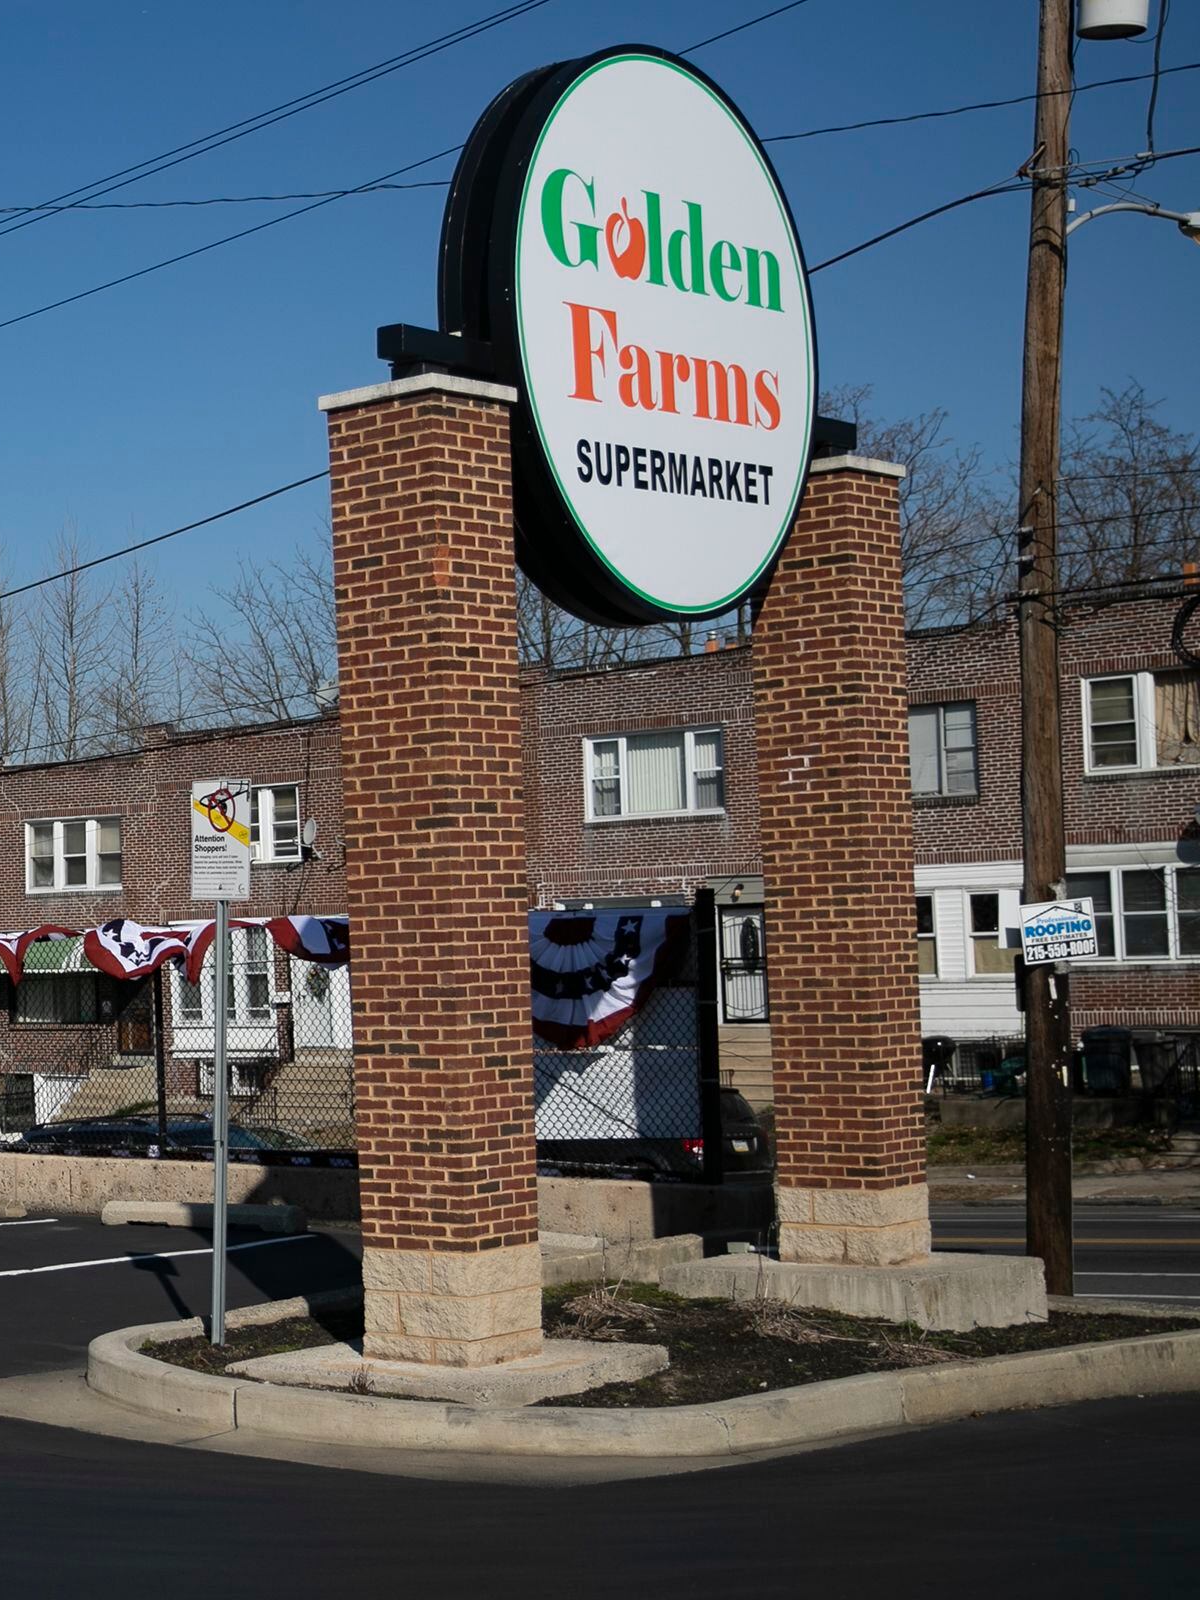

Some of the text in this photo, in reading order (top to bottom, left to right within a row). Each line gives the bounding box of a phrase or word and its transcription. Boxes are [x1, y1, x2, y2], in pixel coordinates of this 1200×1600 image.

[540, 168, 785, 312] Golden
[562, 301, 781, 431] Farms
[576, 438, 774, 506] SUPERMARKET
[194, 844, 227, 852] Shoppers!
[1025, 919, 1091, 938] ROOFING
[1037, 915, 1078, 923] Professional
[1051, 932, 1087, 940] ESTIMATES
[1027, 940, 1094, 960] 215-550-ROOF
